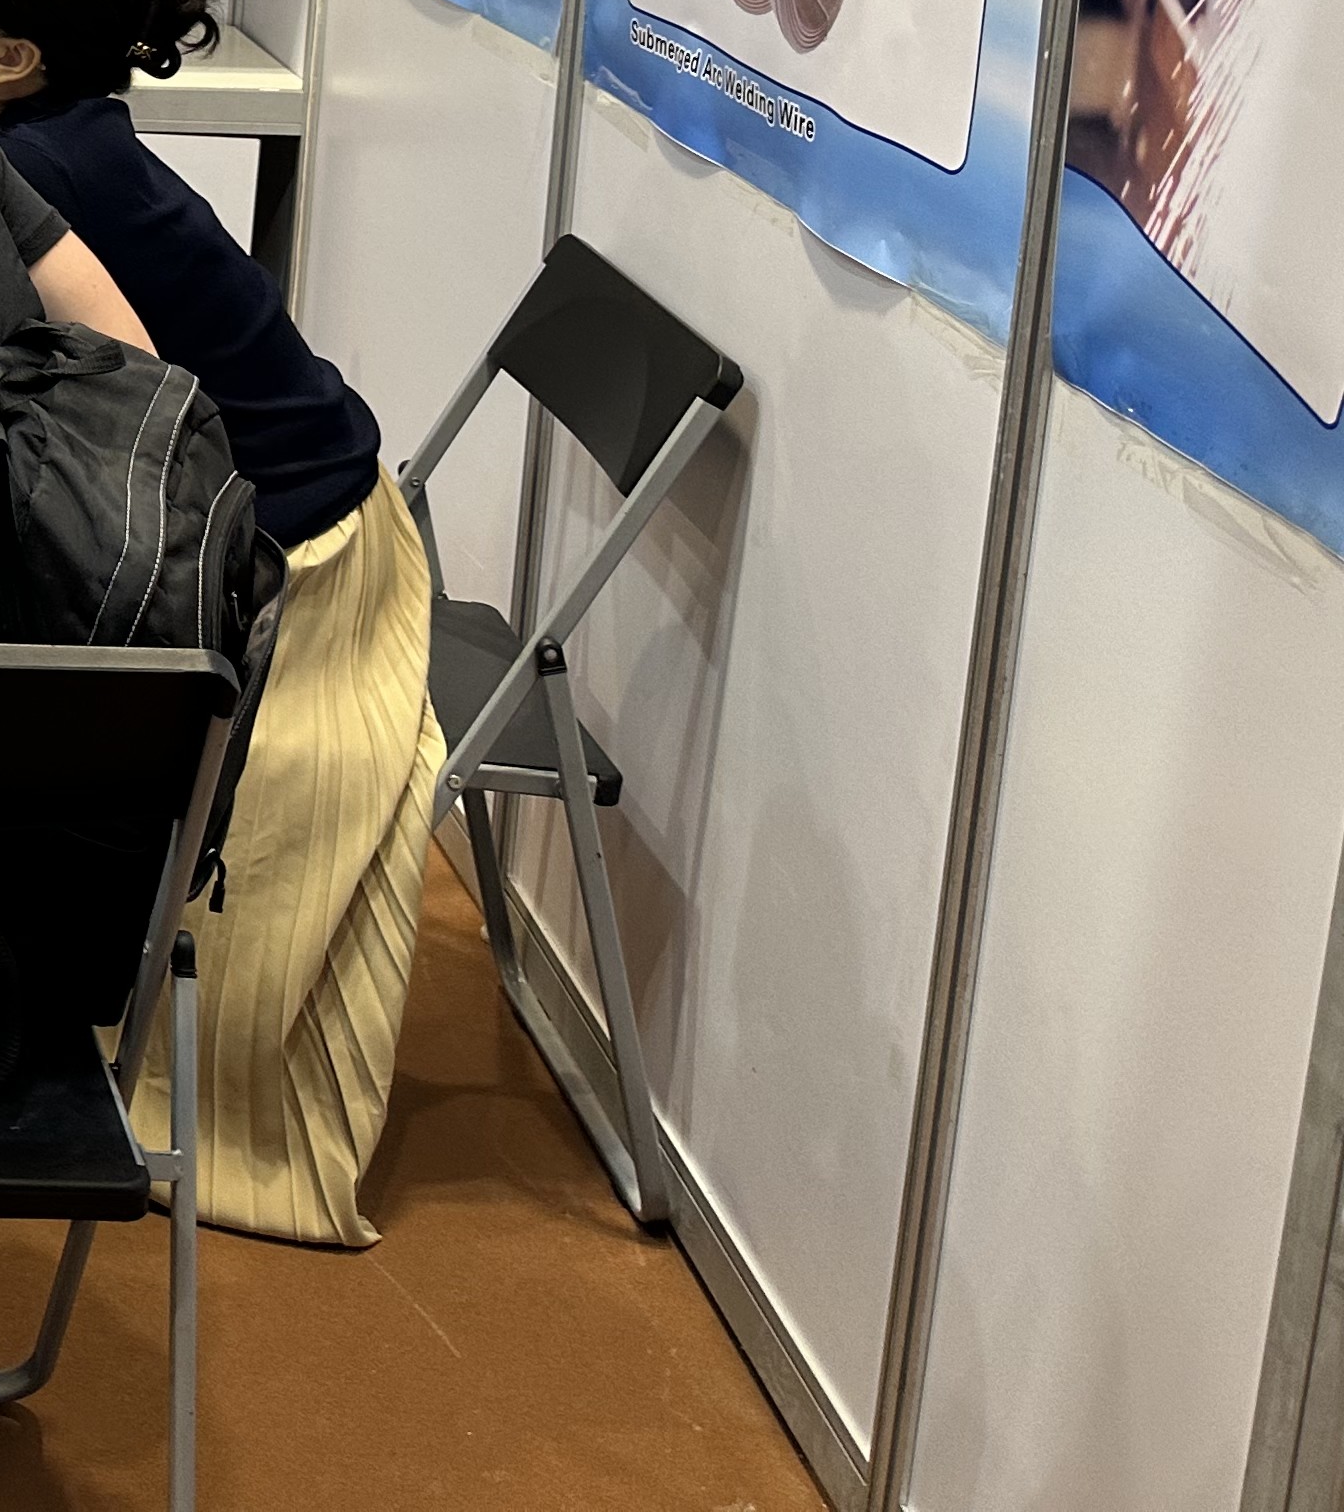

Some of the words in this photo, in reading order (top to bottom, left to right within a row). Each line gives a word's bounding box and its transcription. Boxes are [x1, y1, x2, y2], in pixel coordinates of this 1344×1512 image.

[630, 19, 702, 75] Submerged
[702, 55, 723, 87] Arc
[724, 66, 775, 124] Welding
[779, 97, 815, 140] Wire
